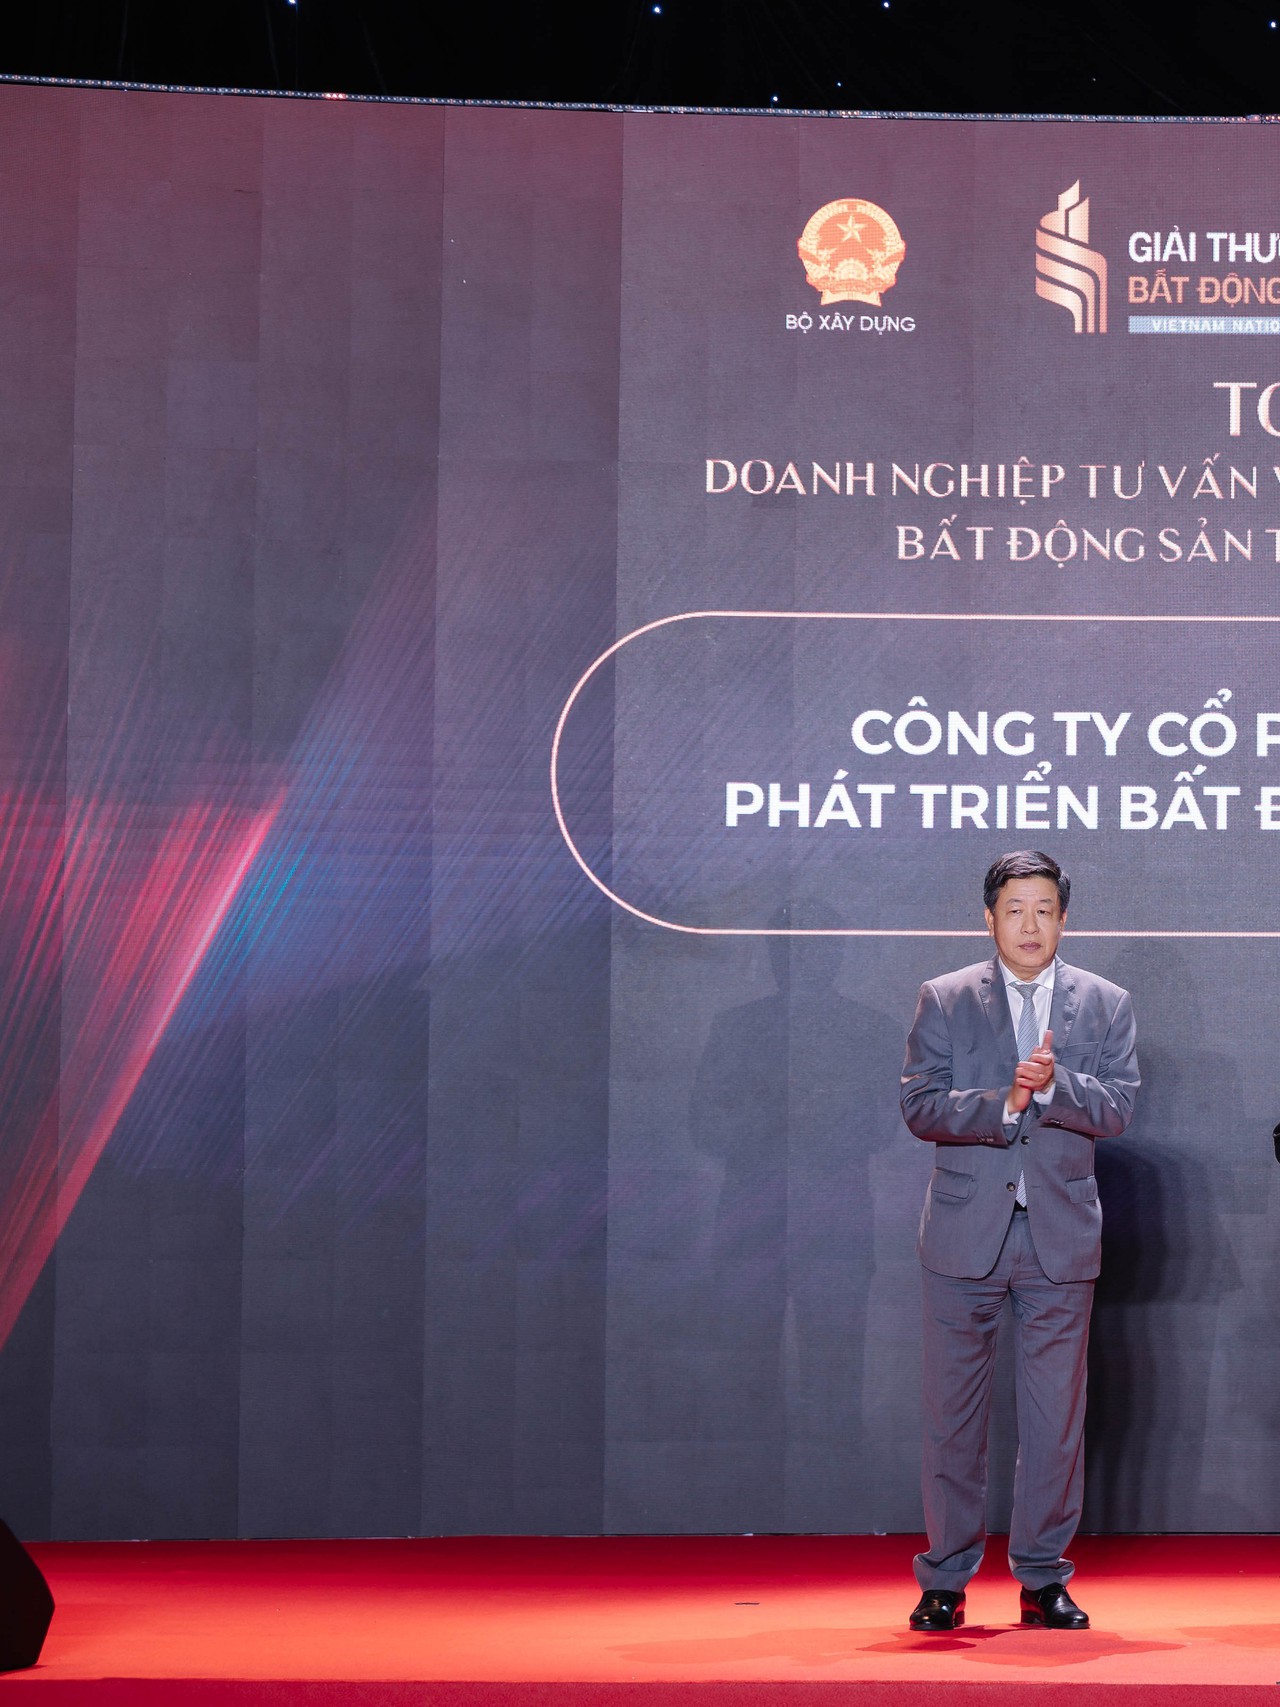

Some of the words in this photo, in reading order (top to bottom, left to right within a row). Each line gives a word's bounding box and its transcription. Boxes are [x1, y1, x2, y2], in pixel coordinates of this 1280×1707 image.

[1128, 224, 1197, 263] GIẢI
[1128, 268, 1190, 304] BẤT
[785, 311, 813, 334] BỘ
[818, 311, 856, 331] XÂY
[860, 314, 916, 336] DỰNG
[1152, 319, 1225, 332] VIETNAM
[705, 459, 876, 496] DOANH
[891, 456, 1066, 506] NGHIỆP
[1079, 460, 1145, 500] TƯ
[1157, 452, 1257, 500] VẤN
[896, 514, 994, 561] BẤT
[1006, 519, 1145, 569] ĐỘNG
[1158, 516, 1253, 563] SẢN
[850, 695, 1036, 757] CÔNG
[1052, 711, 1133, 757] TY
[1147, 687, 1238, 758] CỔ
[725, 768, 896, 829] PHÁT
[909, 760, 1099, 830] TRIỂN
[1119, 764, 1241, 830] BẤT
